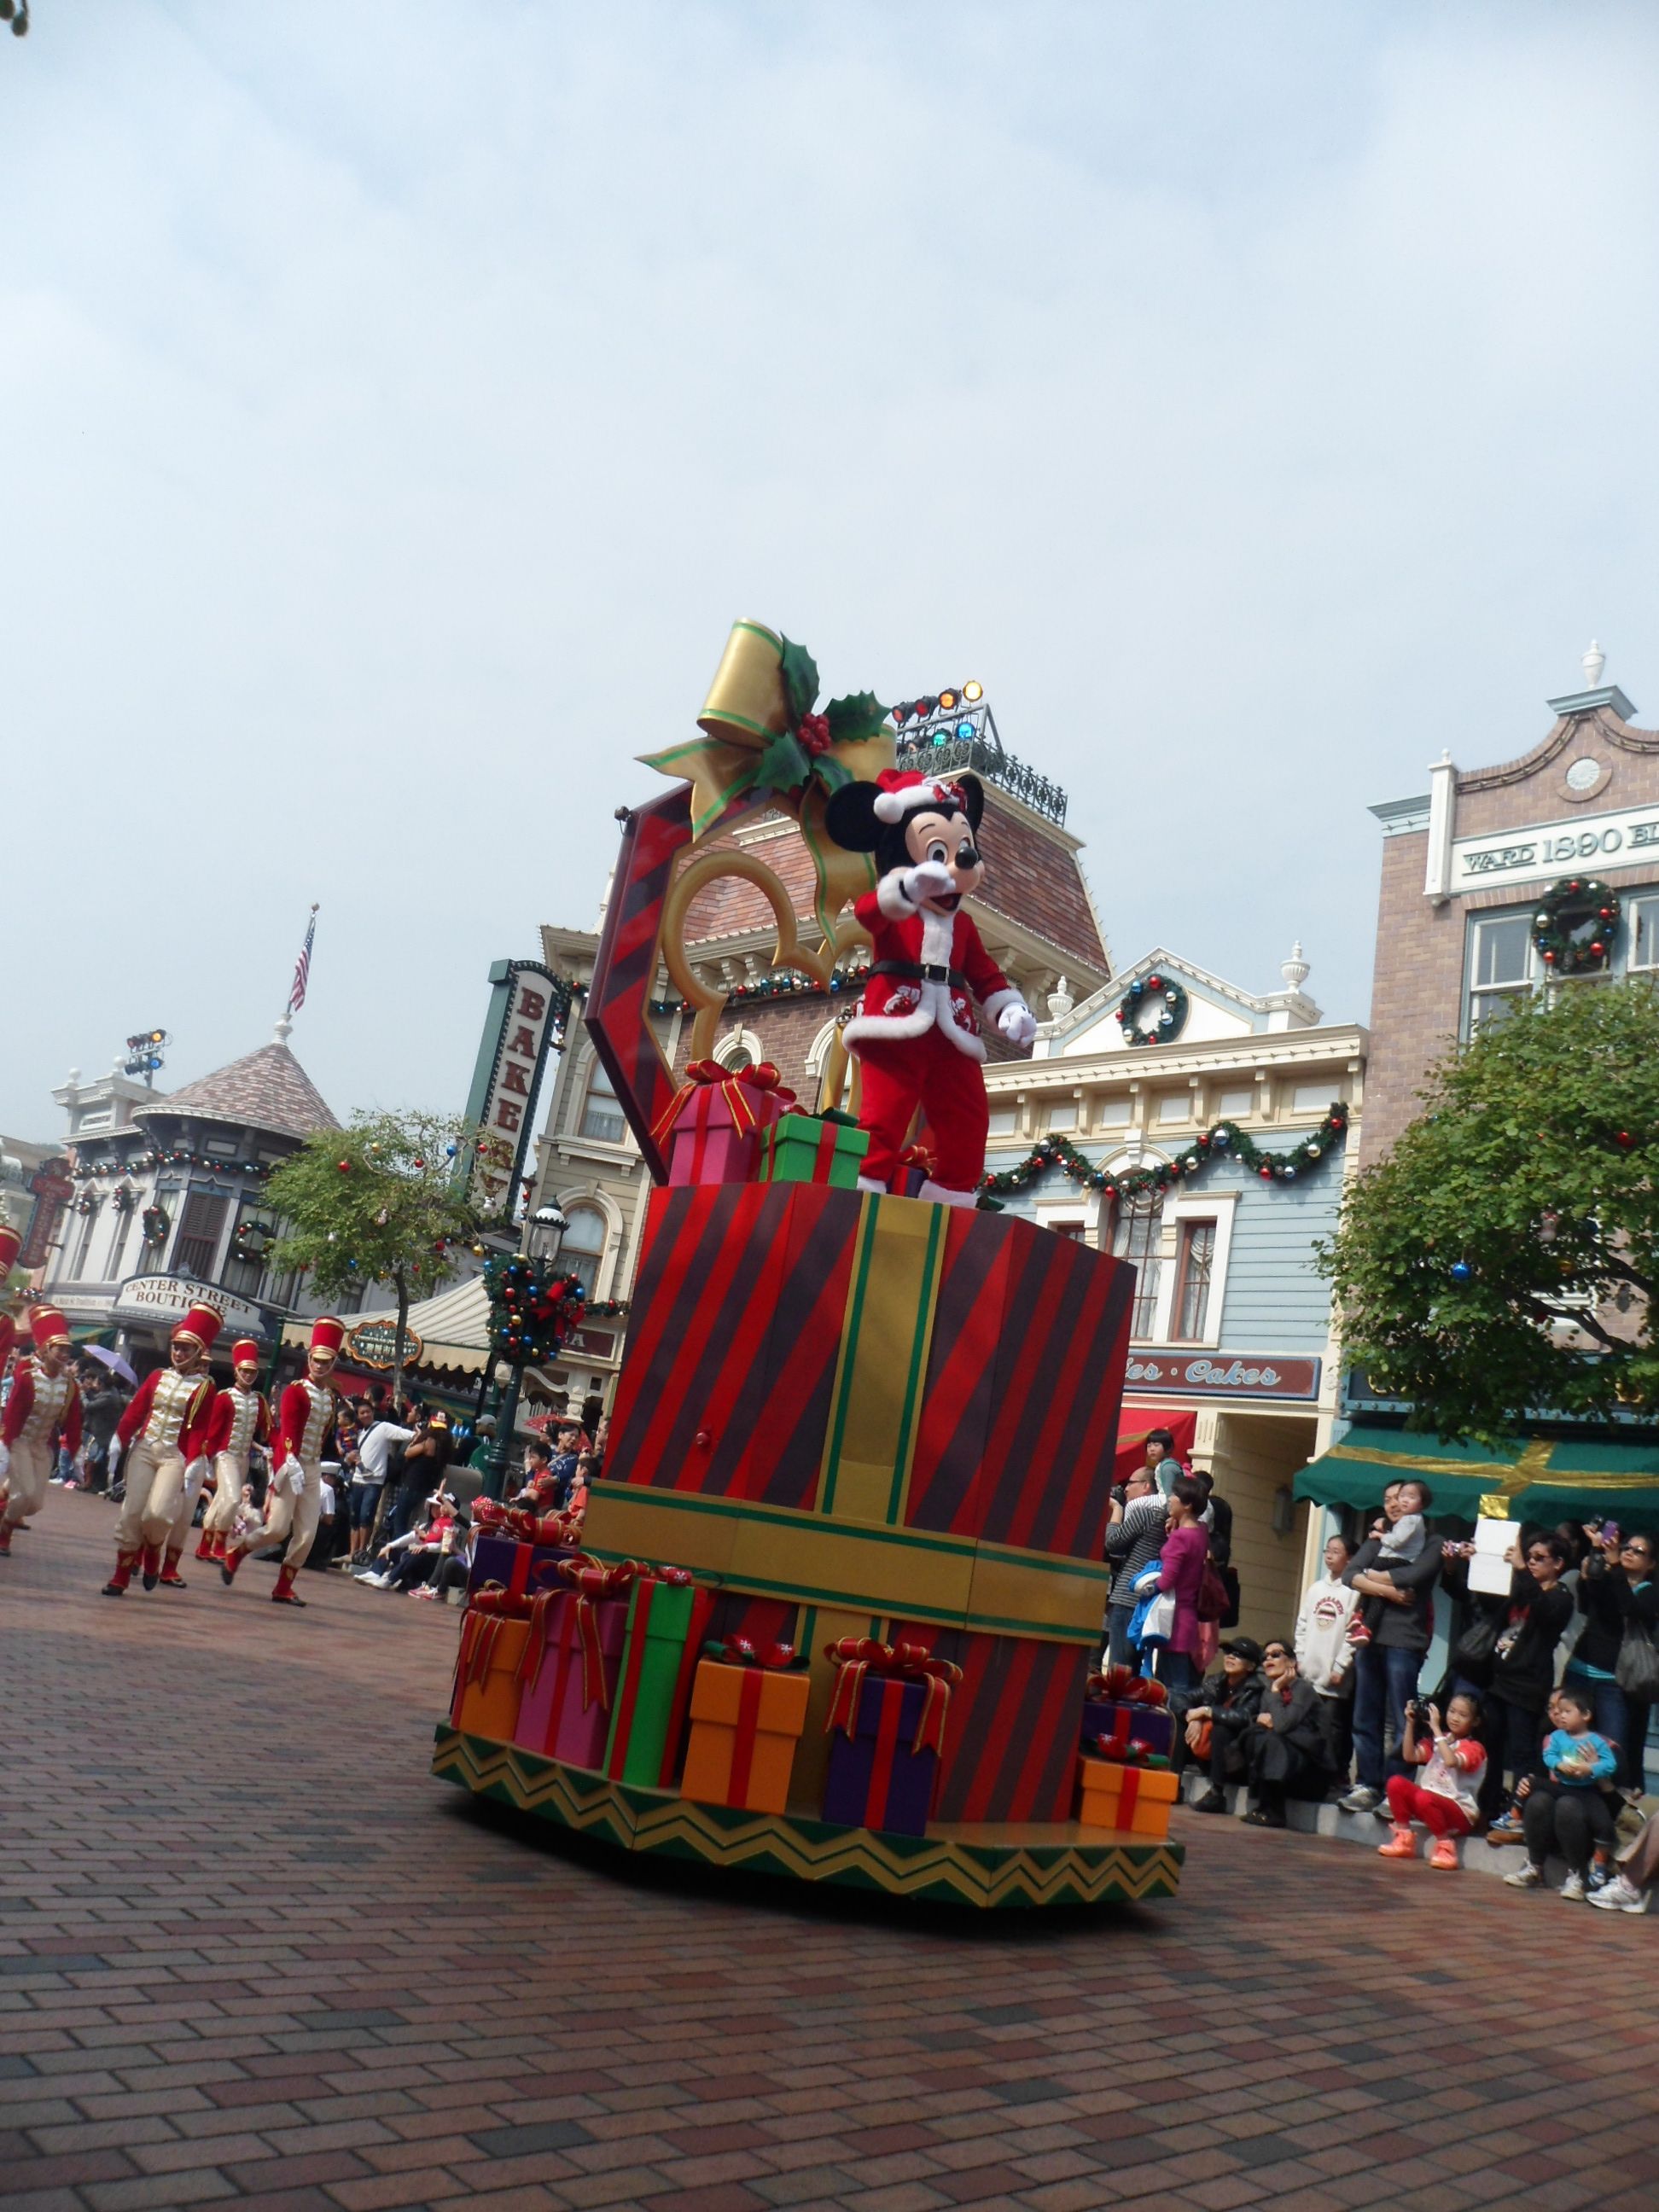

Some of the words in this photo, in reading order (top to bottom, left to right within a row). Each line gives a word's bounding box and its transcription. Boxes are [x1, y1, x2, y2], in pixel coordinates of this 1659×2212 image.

[1463, 847, 1535, 870] WARD
[1542, 828, 1622, 863] 1890
[125, 1279, 182, 1292] CENTER
[183, 1282, 252, 1314] STREET
[135, 1291, 227, 1317] BOUTIE
[1185, 1360, 1281, 1386] Cakes
